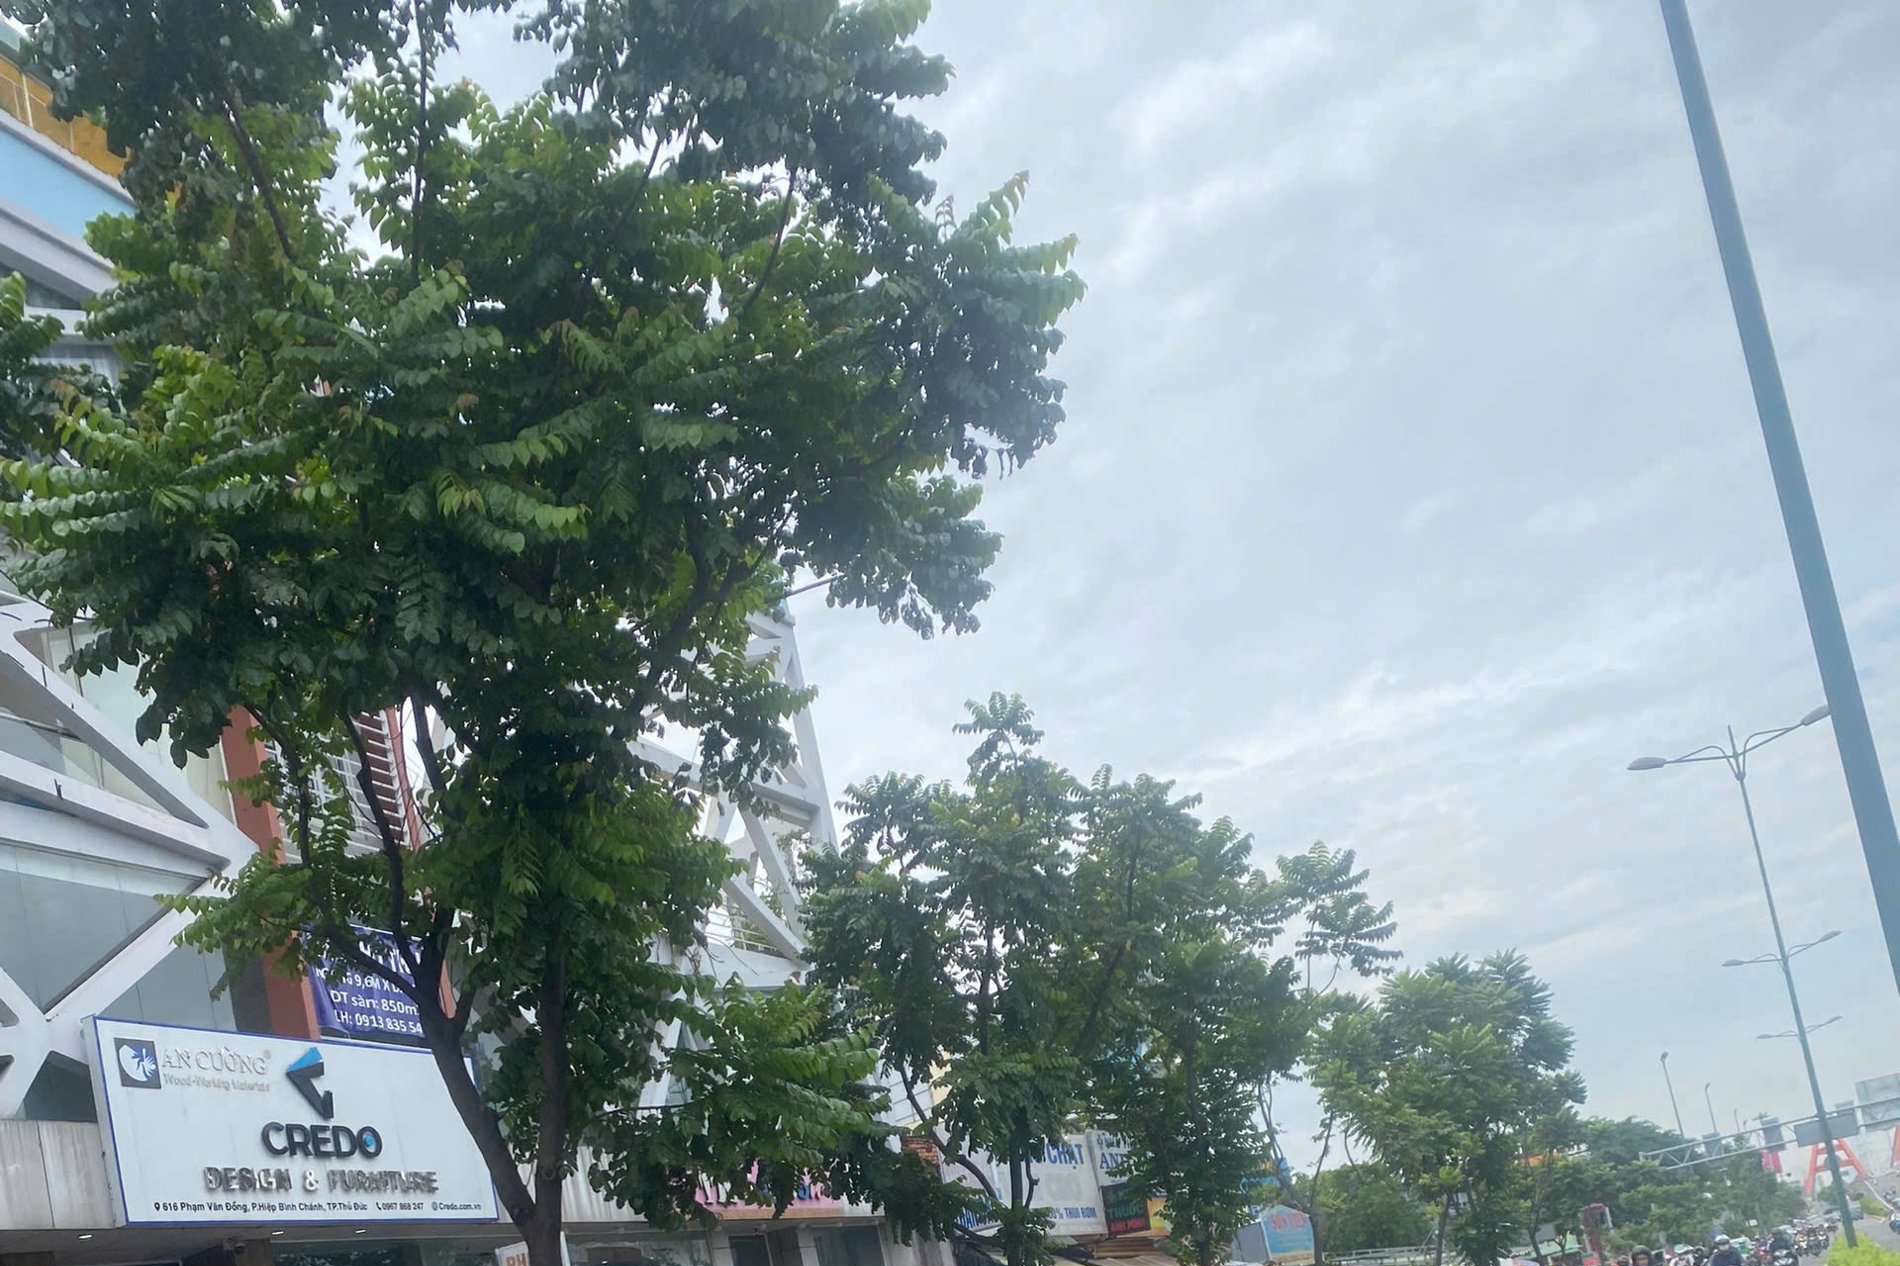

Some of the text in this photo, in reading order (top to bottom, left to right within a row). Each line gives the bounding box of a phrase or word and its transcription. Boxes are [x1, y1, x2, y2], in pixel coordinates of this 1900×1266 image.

[330, 989, 348, 1004] DT
[351, 994, 380, 1009] sàn:
[334, 1009, 353, 1025] LH:
[355, 1013, 384, 1029] 0913
[386, 1017, 407, 1032] 835
[262, 1121, 383, 1159] CREDO
[203, 1166, 440, 1194] DESIGN & FURNITURE
[162, 1201, 179, 1211] 616
[180, 1201, 205, 1213] Phạm
